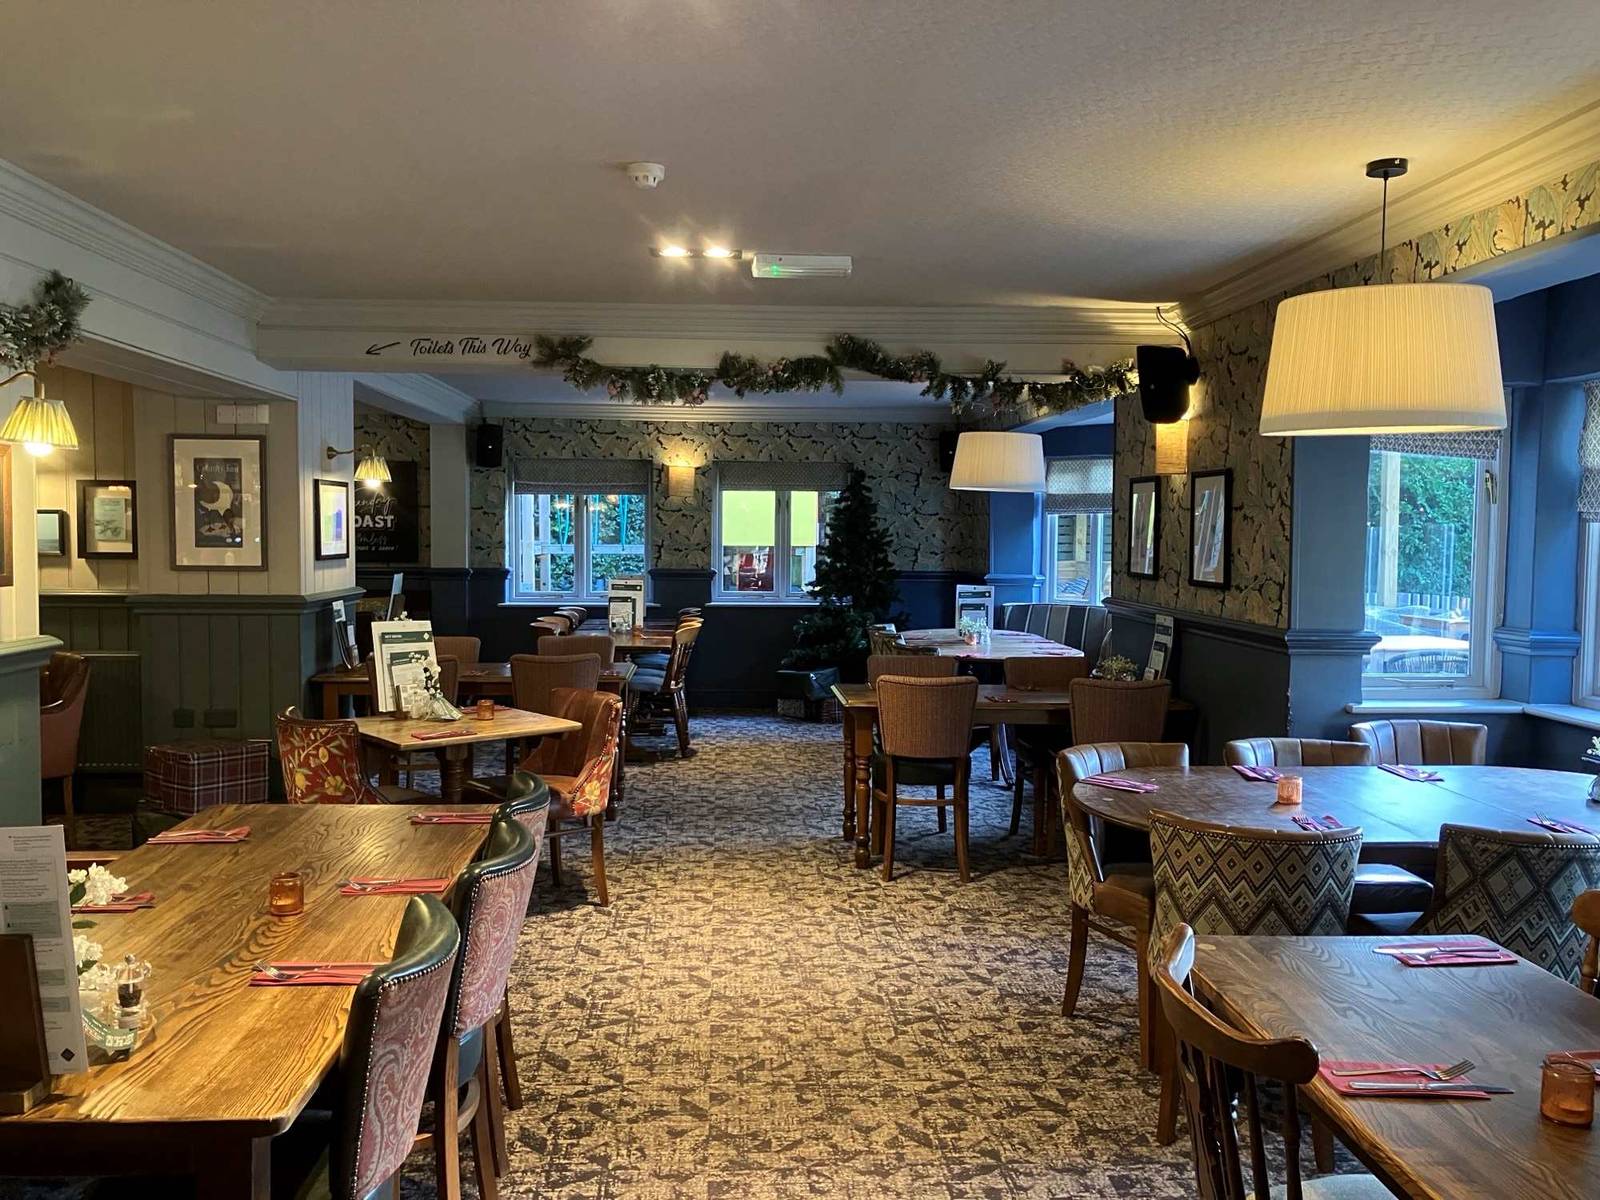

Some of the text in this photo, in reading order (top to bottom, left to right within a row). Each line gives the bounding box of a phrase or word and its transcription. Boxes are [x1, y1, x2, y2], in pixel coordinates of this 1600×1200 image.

[410, 337, 532, 359] Toilets This Way
[355, 514, 394, 528] OAST
